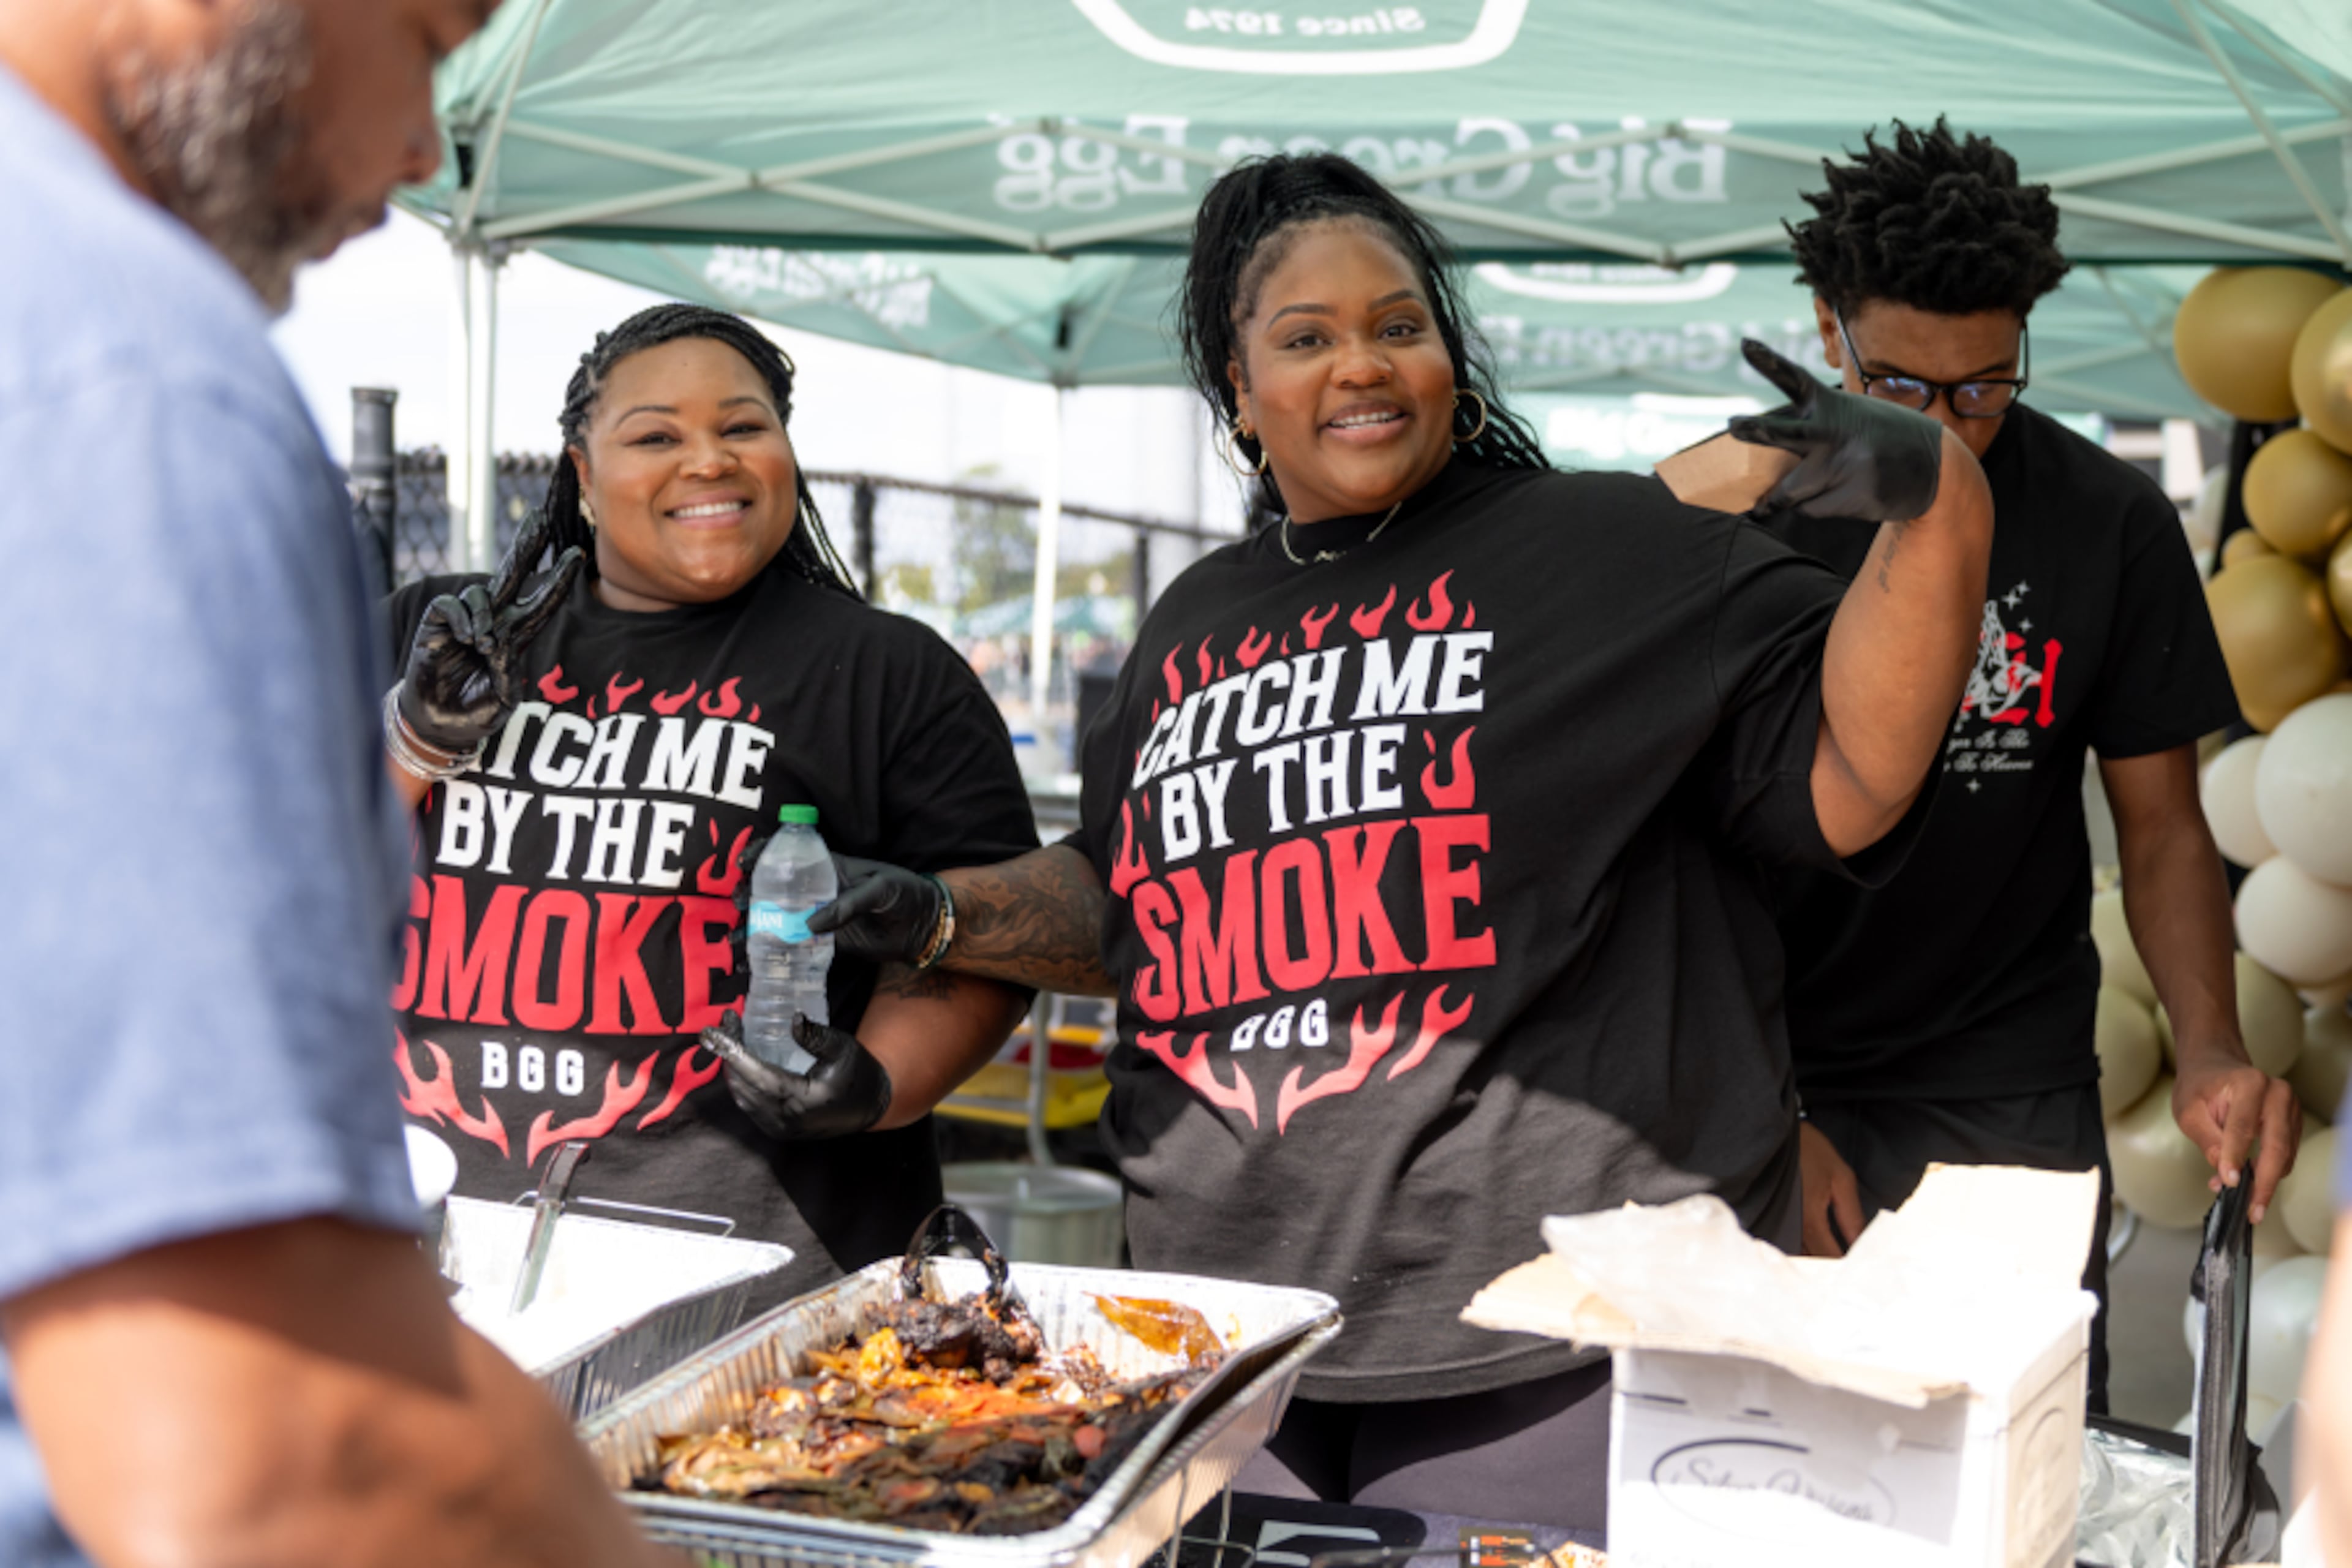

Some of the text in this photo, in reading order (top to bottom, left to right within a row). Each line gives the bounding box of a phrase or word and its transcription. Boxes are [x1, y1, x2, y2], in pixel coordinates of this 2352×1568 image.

[469, 700, 776, 810] TCH ME
[1132, 631, 1494, 791] CATCH ME
[435, 779, 696, 889] BY THE
[1159, 723, 1408, 864] BY THE
[1131, 813, 1498, 1023] SMOKE
[479, 1039, 586, 1097] BGG
